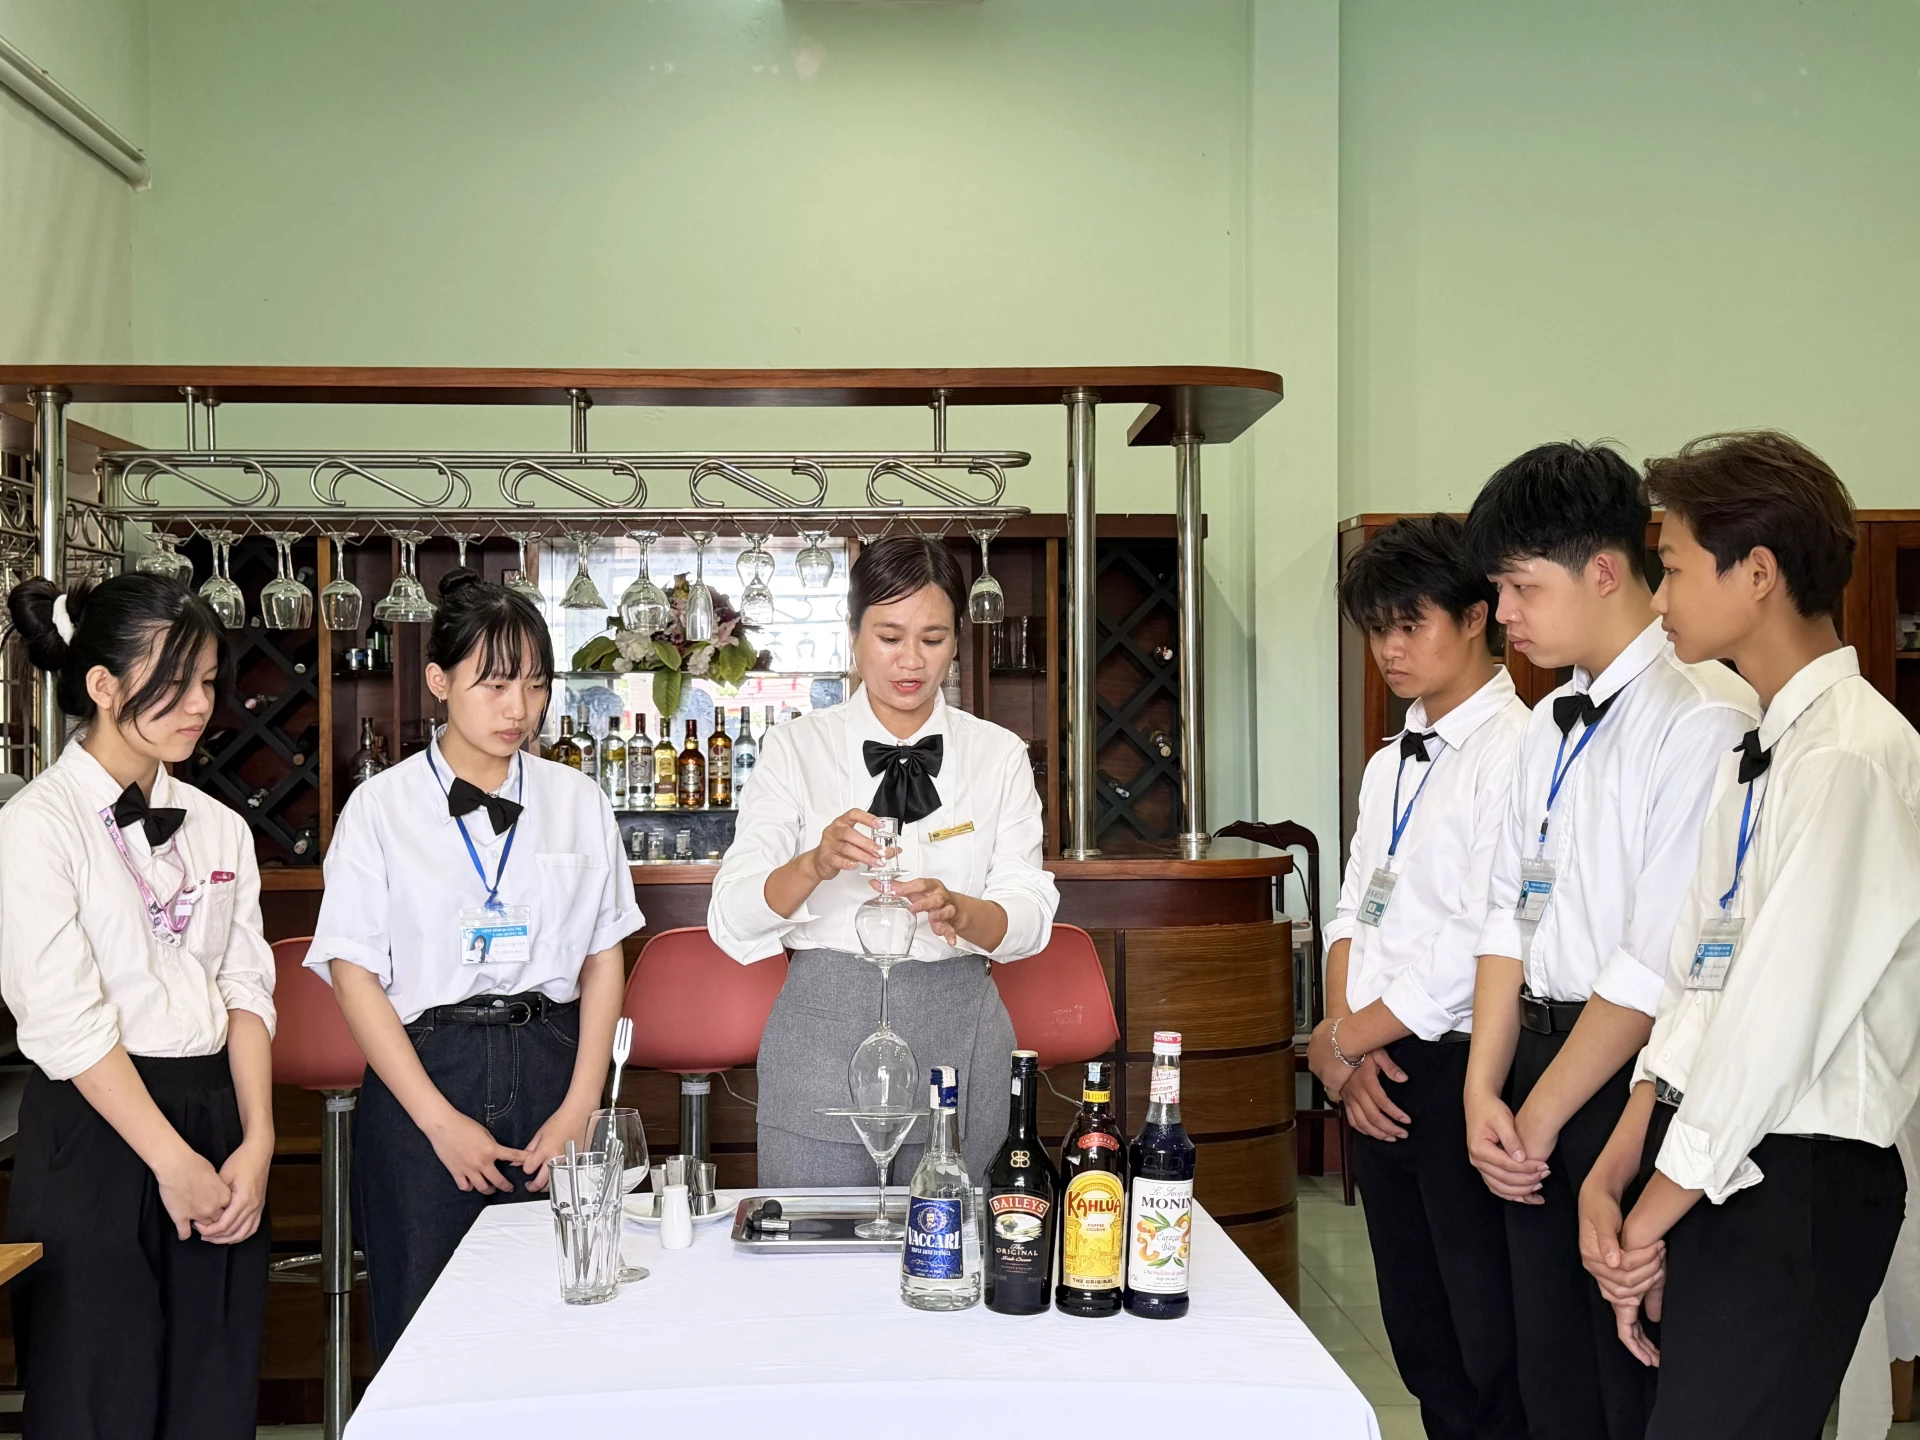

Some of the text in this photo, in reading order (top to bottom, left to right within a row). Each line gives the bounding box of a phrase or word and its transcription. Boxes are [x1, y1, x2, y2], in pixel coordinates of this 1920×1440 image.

[1082, 1137, 1115, 1146] IMPORTED
[992, 1197, 1047, 1213] BAILEYS
[1068, 1191, 1121, 1219] KAHLÚA
[1141, 1196, 1192, 1210] MONIN
[995, 1247, 1039, 1257] ORIGINAL
